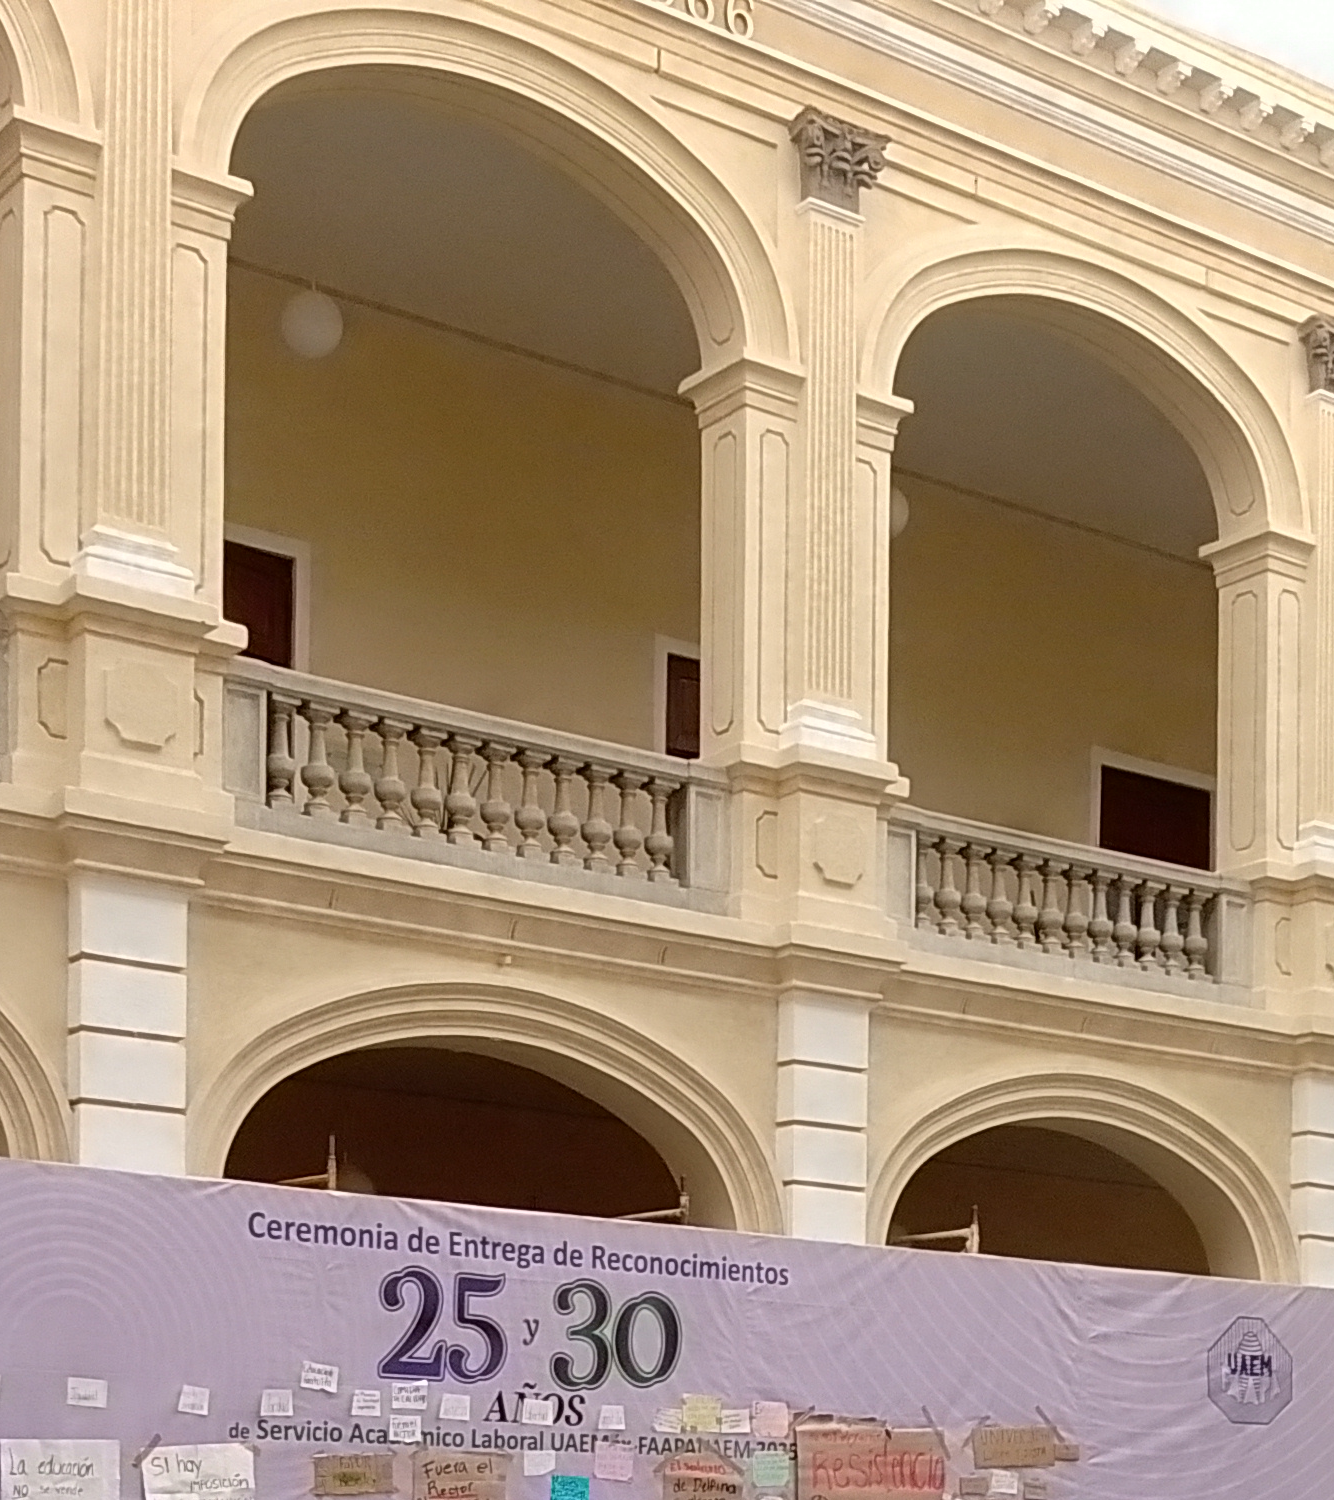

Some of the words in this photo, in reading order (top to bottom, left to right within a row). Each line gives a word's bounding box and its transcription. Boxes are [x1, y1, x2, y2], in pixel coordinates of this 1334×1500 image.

[248, 1212, 398, 1251] Ceremonia
[407, 1226, 440, 1255] de
[448, 1231, 545, 1269] Entrega
[553, 1240, 584, 1267] de
[591, 1245, 789, 1285] Reconocimientos
[377, 1265, 508, 1384] 25
[522, 1318, 540, 1345] y
[549, 1277, 683, 1392] 30
[1227, 1352, 1273, 1378] UAEM
[229, 1422, 250, 1439] de
[256, 1418, 343, 1443] Servicio
[349, 1421, 465, 1448] Acamico
[471, 1428, 544, 1451] Laboral
[8, 1447, 28, 1476] La
[37, 1454, 94, 1478] educación
[175, 1452, 202, 1479] hay
[422, 1460, 469, 1479] Fuera
[476, 1458, 493, 1474] el
[12, 1484, 29, 1499] NO
[427, 1480, 474, 1498] Rector
[673, 1478, 687, 1493] de
